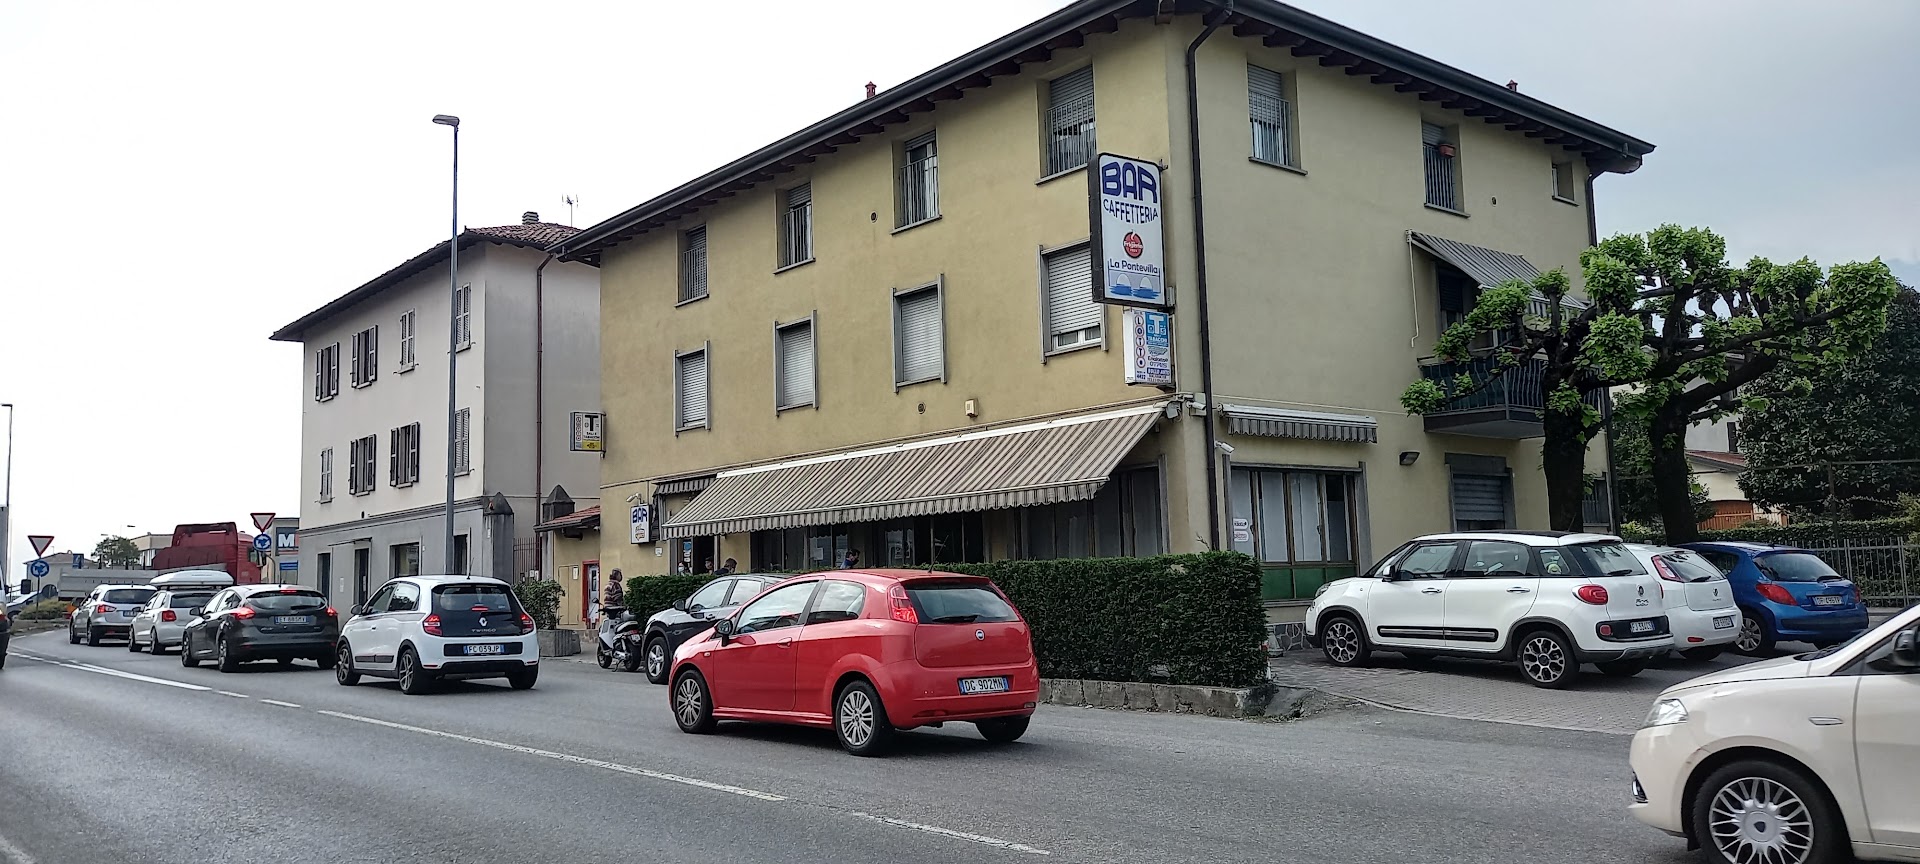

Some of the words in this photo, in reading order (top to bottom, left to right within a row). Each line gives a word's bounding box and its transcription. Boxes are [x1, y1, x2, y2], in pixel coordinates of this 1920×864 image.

[1101, 161, 1158, 204] BAR
[1103, 198, 1159, 224] CAFFETTERIA
[1109, 258, 1120, 269] La
[1121, 259, 1158, 274] Pontevilla
[632, 507, 648, 523] BAR
[977, 678, 1004, 690] 902MN
